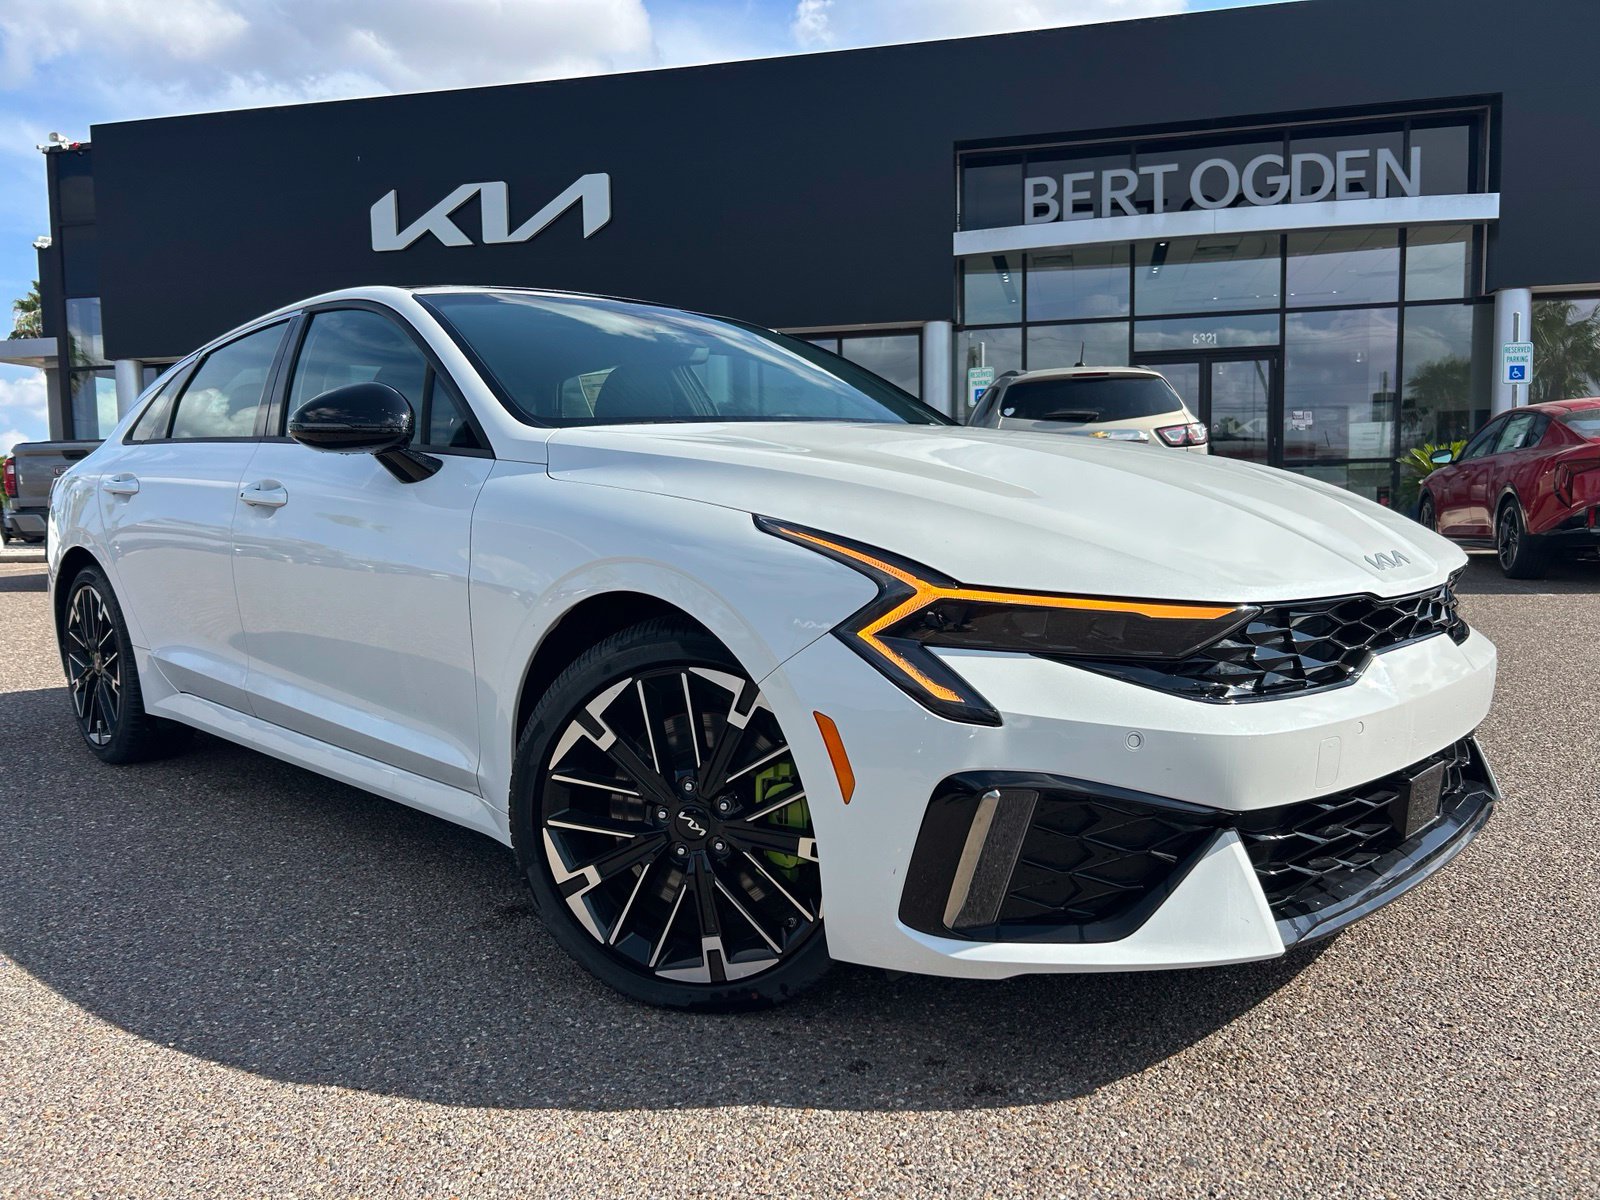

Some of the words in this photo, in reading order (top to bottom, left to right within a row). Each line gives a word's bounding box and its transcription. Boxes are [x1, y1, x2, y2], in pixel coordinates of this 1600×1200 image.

[1024, 163, 1179, 225] BERT
[1189, 146, 1422, 211] OGDEN
[370, 172, 612, 252] KIA
[1506, 355, 1529, 363] PARKING
[1363, 549, 1411, 570] KIA
